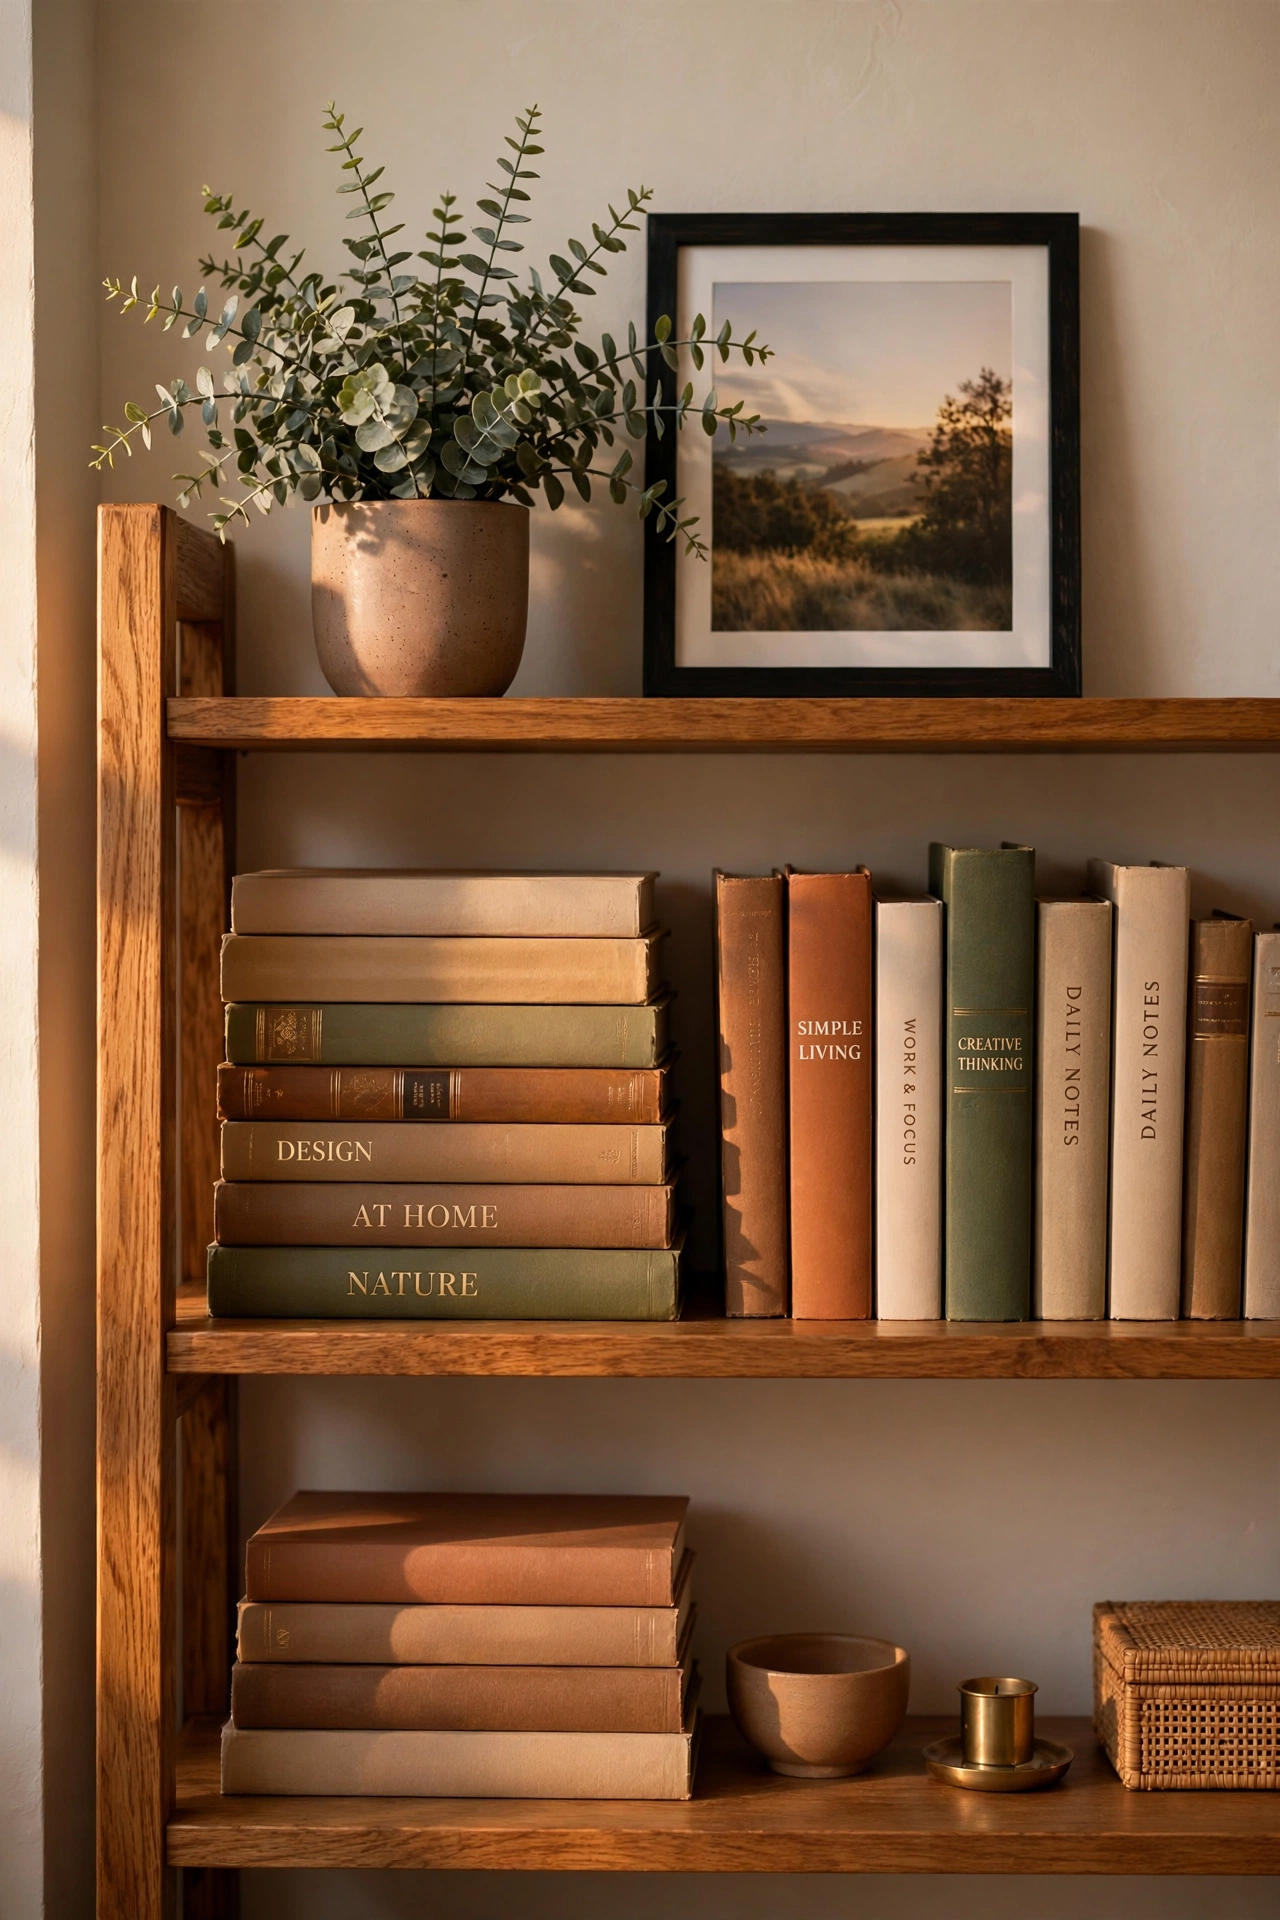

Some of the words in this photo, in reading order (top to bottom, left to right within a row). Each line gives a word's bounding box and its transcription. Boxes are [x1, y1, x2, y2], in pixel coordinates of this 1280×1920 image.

[797, 1020, 863, 1036] SIMPLE
[1065, 986, 1082, 1057] DAILY
[1142, 981, 1160, 1057] NOTES
[798, 1044, 861, 1060] LIVING
[903, 1018, 917, 1075] WORK
[957, 1036, 1022, 1051] CREATIVE
[957, 1056, 1023, 1071] THINKING
[903, 1083, 916, 1095] &
[1063, 1068, 1080, 1146] NOTES
[1140, 1068, 1158, 1140] DAILY
[903, 1103, 916, 1165] FOCUS
[277, 1140, 373, 1162] DESIGN
[352, 1203, 392, 1228] AT
[403, 1204, 498, 1229] HOME
[347, 1271, 478, 1297] NATURE
